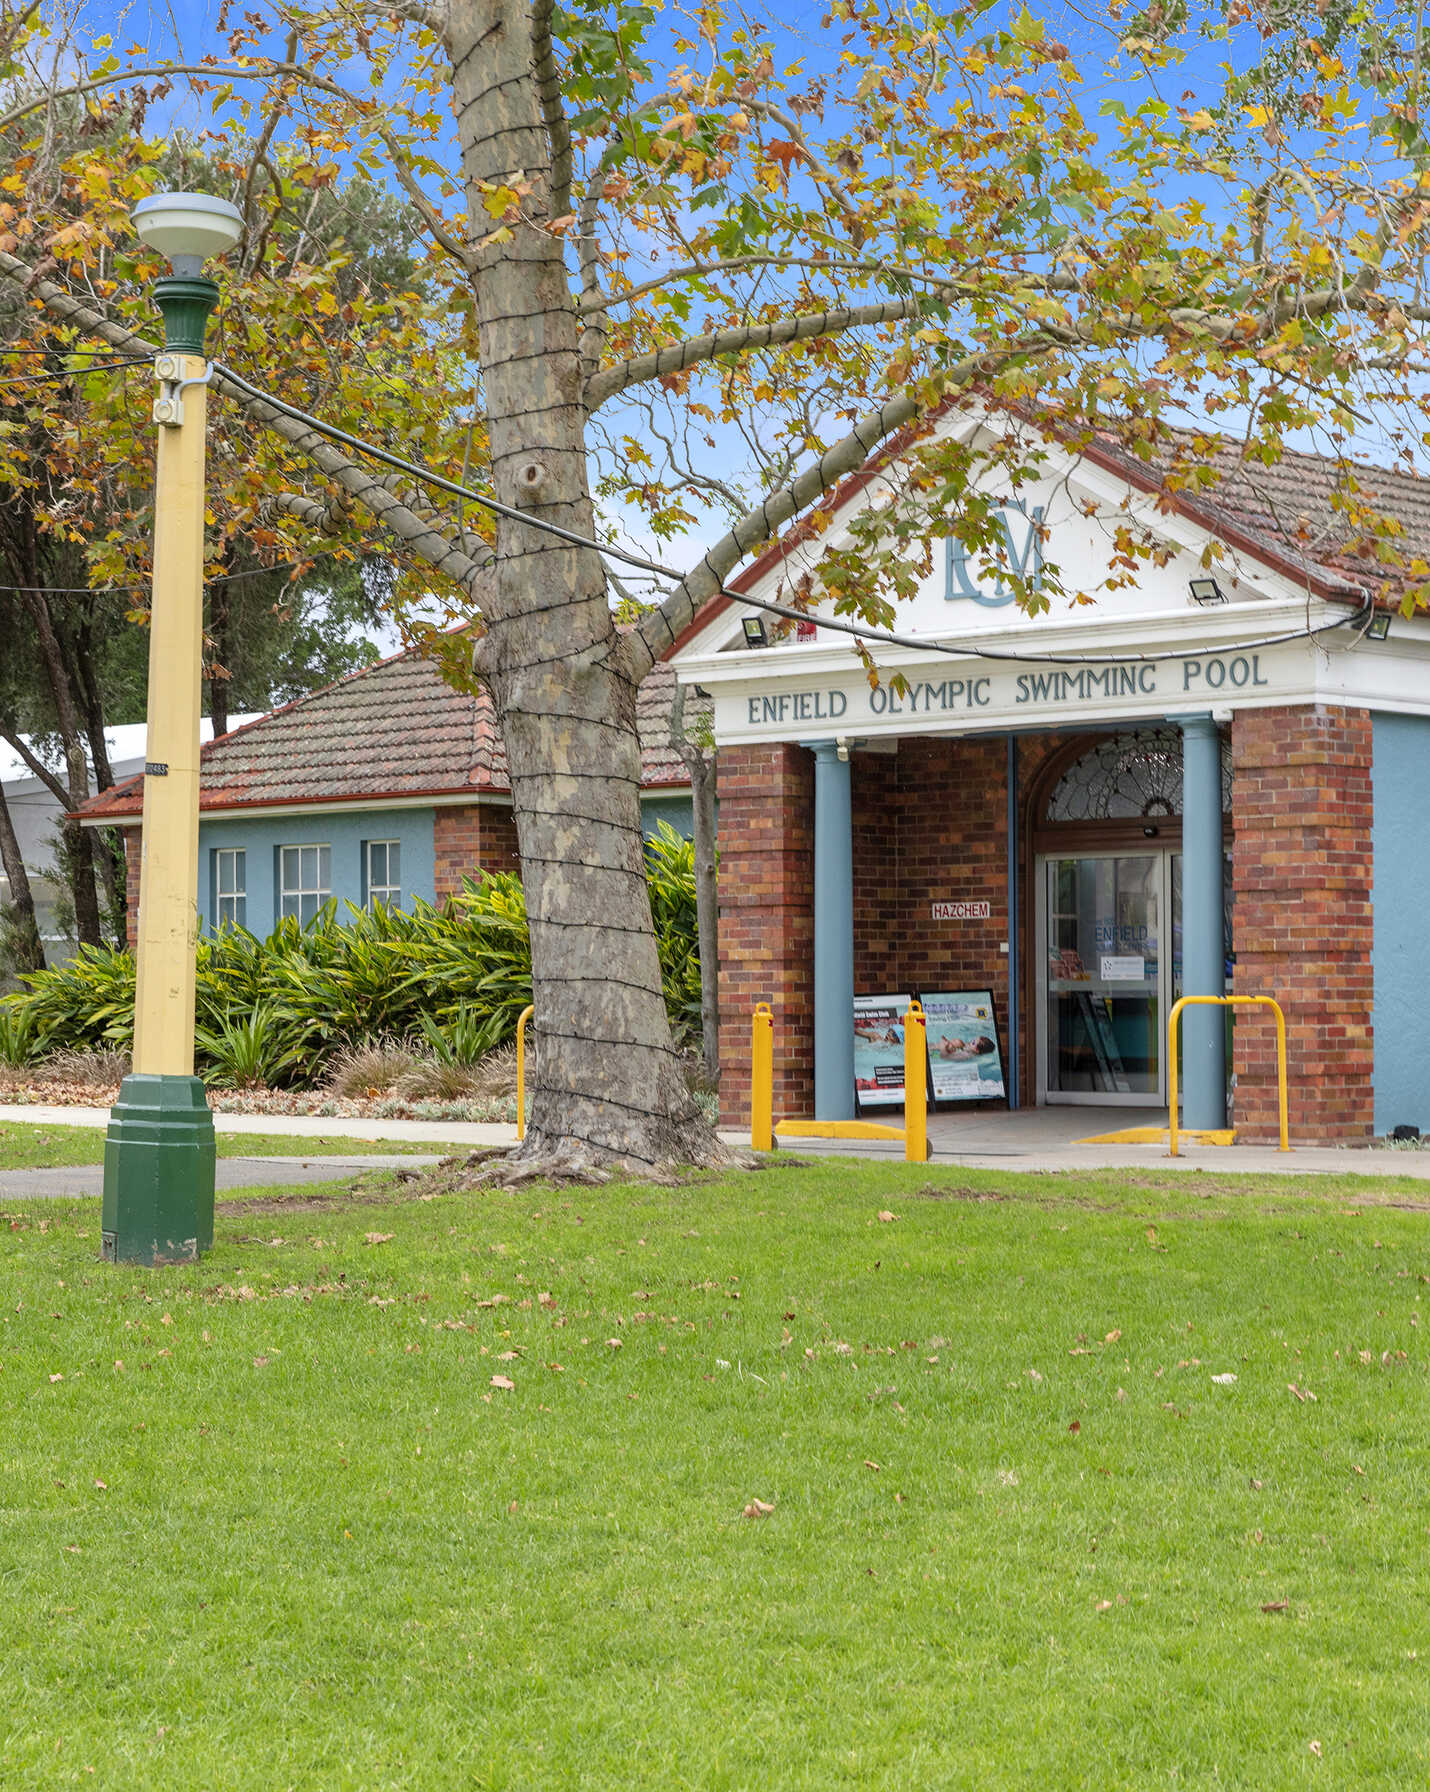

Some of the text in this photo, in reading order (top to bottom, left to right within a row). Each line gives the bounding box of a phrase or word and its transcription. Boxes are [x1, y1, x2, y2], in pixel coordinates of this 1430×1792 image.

[748, 655, 1268, 724] ENFIELD OLYMPIC SWIMMING POOL
[934, 903, 988, 918] HAZCHEM
[1095, 926, 1148, 942] ENFIELD
